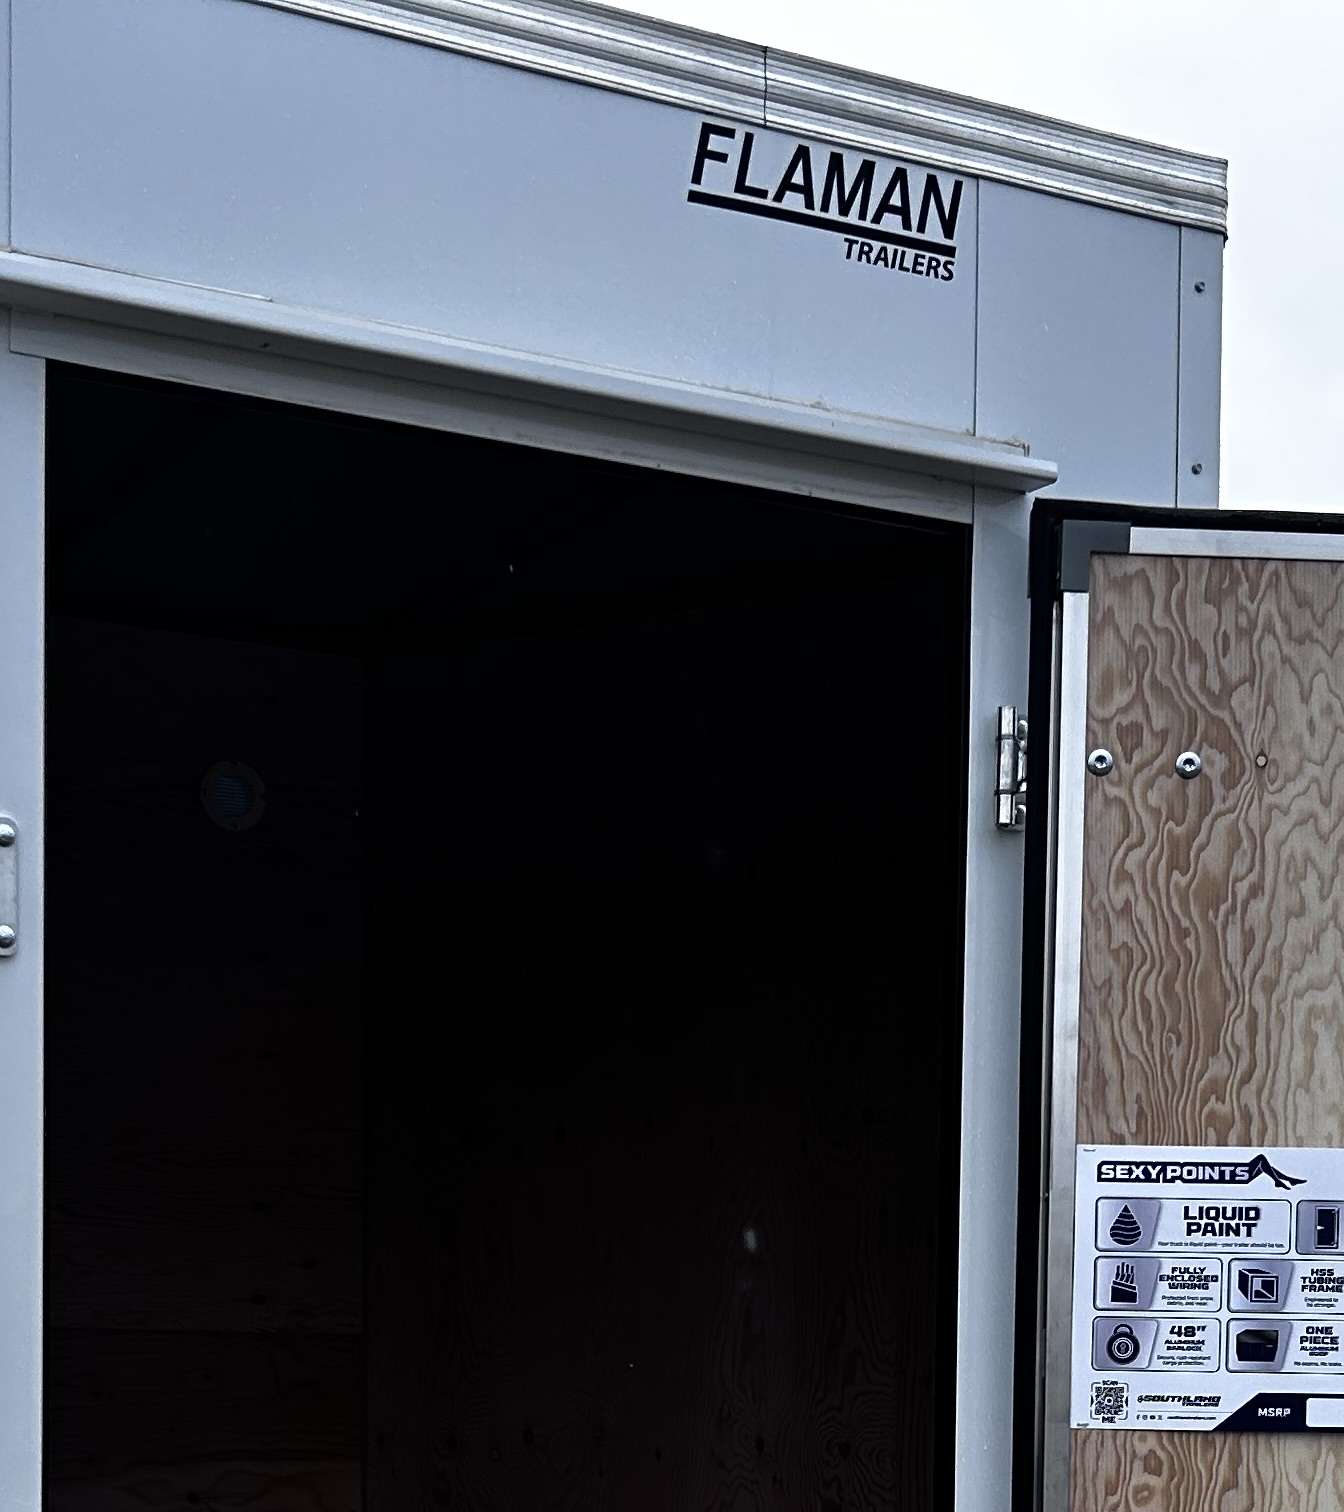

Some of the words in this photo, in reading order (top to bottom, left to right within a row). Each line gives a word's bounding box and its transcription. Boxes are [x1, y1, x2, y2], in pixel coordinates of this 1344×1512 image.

[690, 121, 964, 240] FLAMAN
[843, 238, 956, 282] TRAILERS
[1100, 1164, 1162, 1180] SEXY
[1166, 1165, 1250, 1181] POINTS
[1183, 1205, 1261, 1223] LIQUID
[1185, 1222, 1258, 1238] PAINT
[1170, 1266, 1207, 1275] FULLY
[1310, 1268, 1335, 1277] HSS
[1158, 1274, 1219, 1283] ENCLOSED
[1300, 1276, 1344, 1285] TUBING
[1167, 1282, 1210, 1291] WIRING
[1301, 1284, 1344, 1293] FRAME
[1305, 1326, 1334, 1335] ONE
[1299, 1335, 1340, 1346] PIECE
[1257, 1407, 1291, 1417] MSRP
